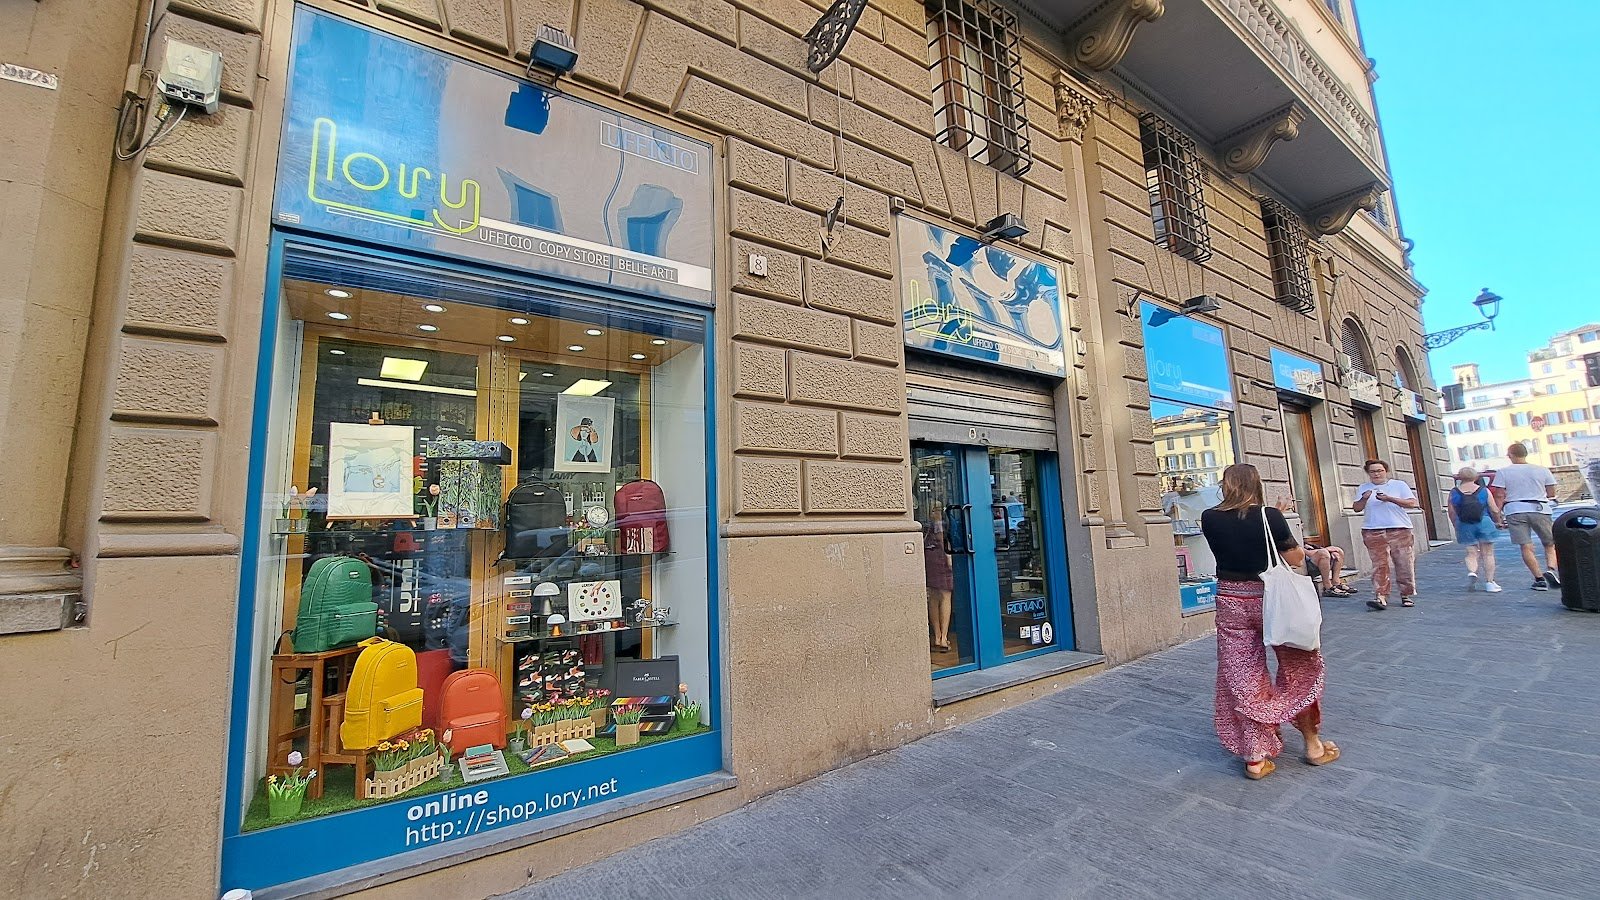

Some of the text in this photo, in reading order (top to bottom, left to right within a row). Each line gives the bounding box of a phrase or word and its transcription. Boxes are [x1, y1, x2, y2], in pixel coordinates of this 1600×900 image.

[607, 125, 694, 171] UFFICIO
[479, 228, 675, 281] UFFICIO COPY STORE BELLE ARTI
[755, 258, 762, 271] 8
[972, 338, 993, 350] UFFICIO
[405, 777, 618, 847] http://shop.lory.net
[407, 789, 489, 821] online
